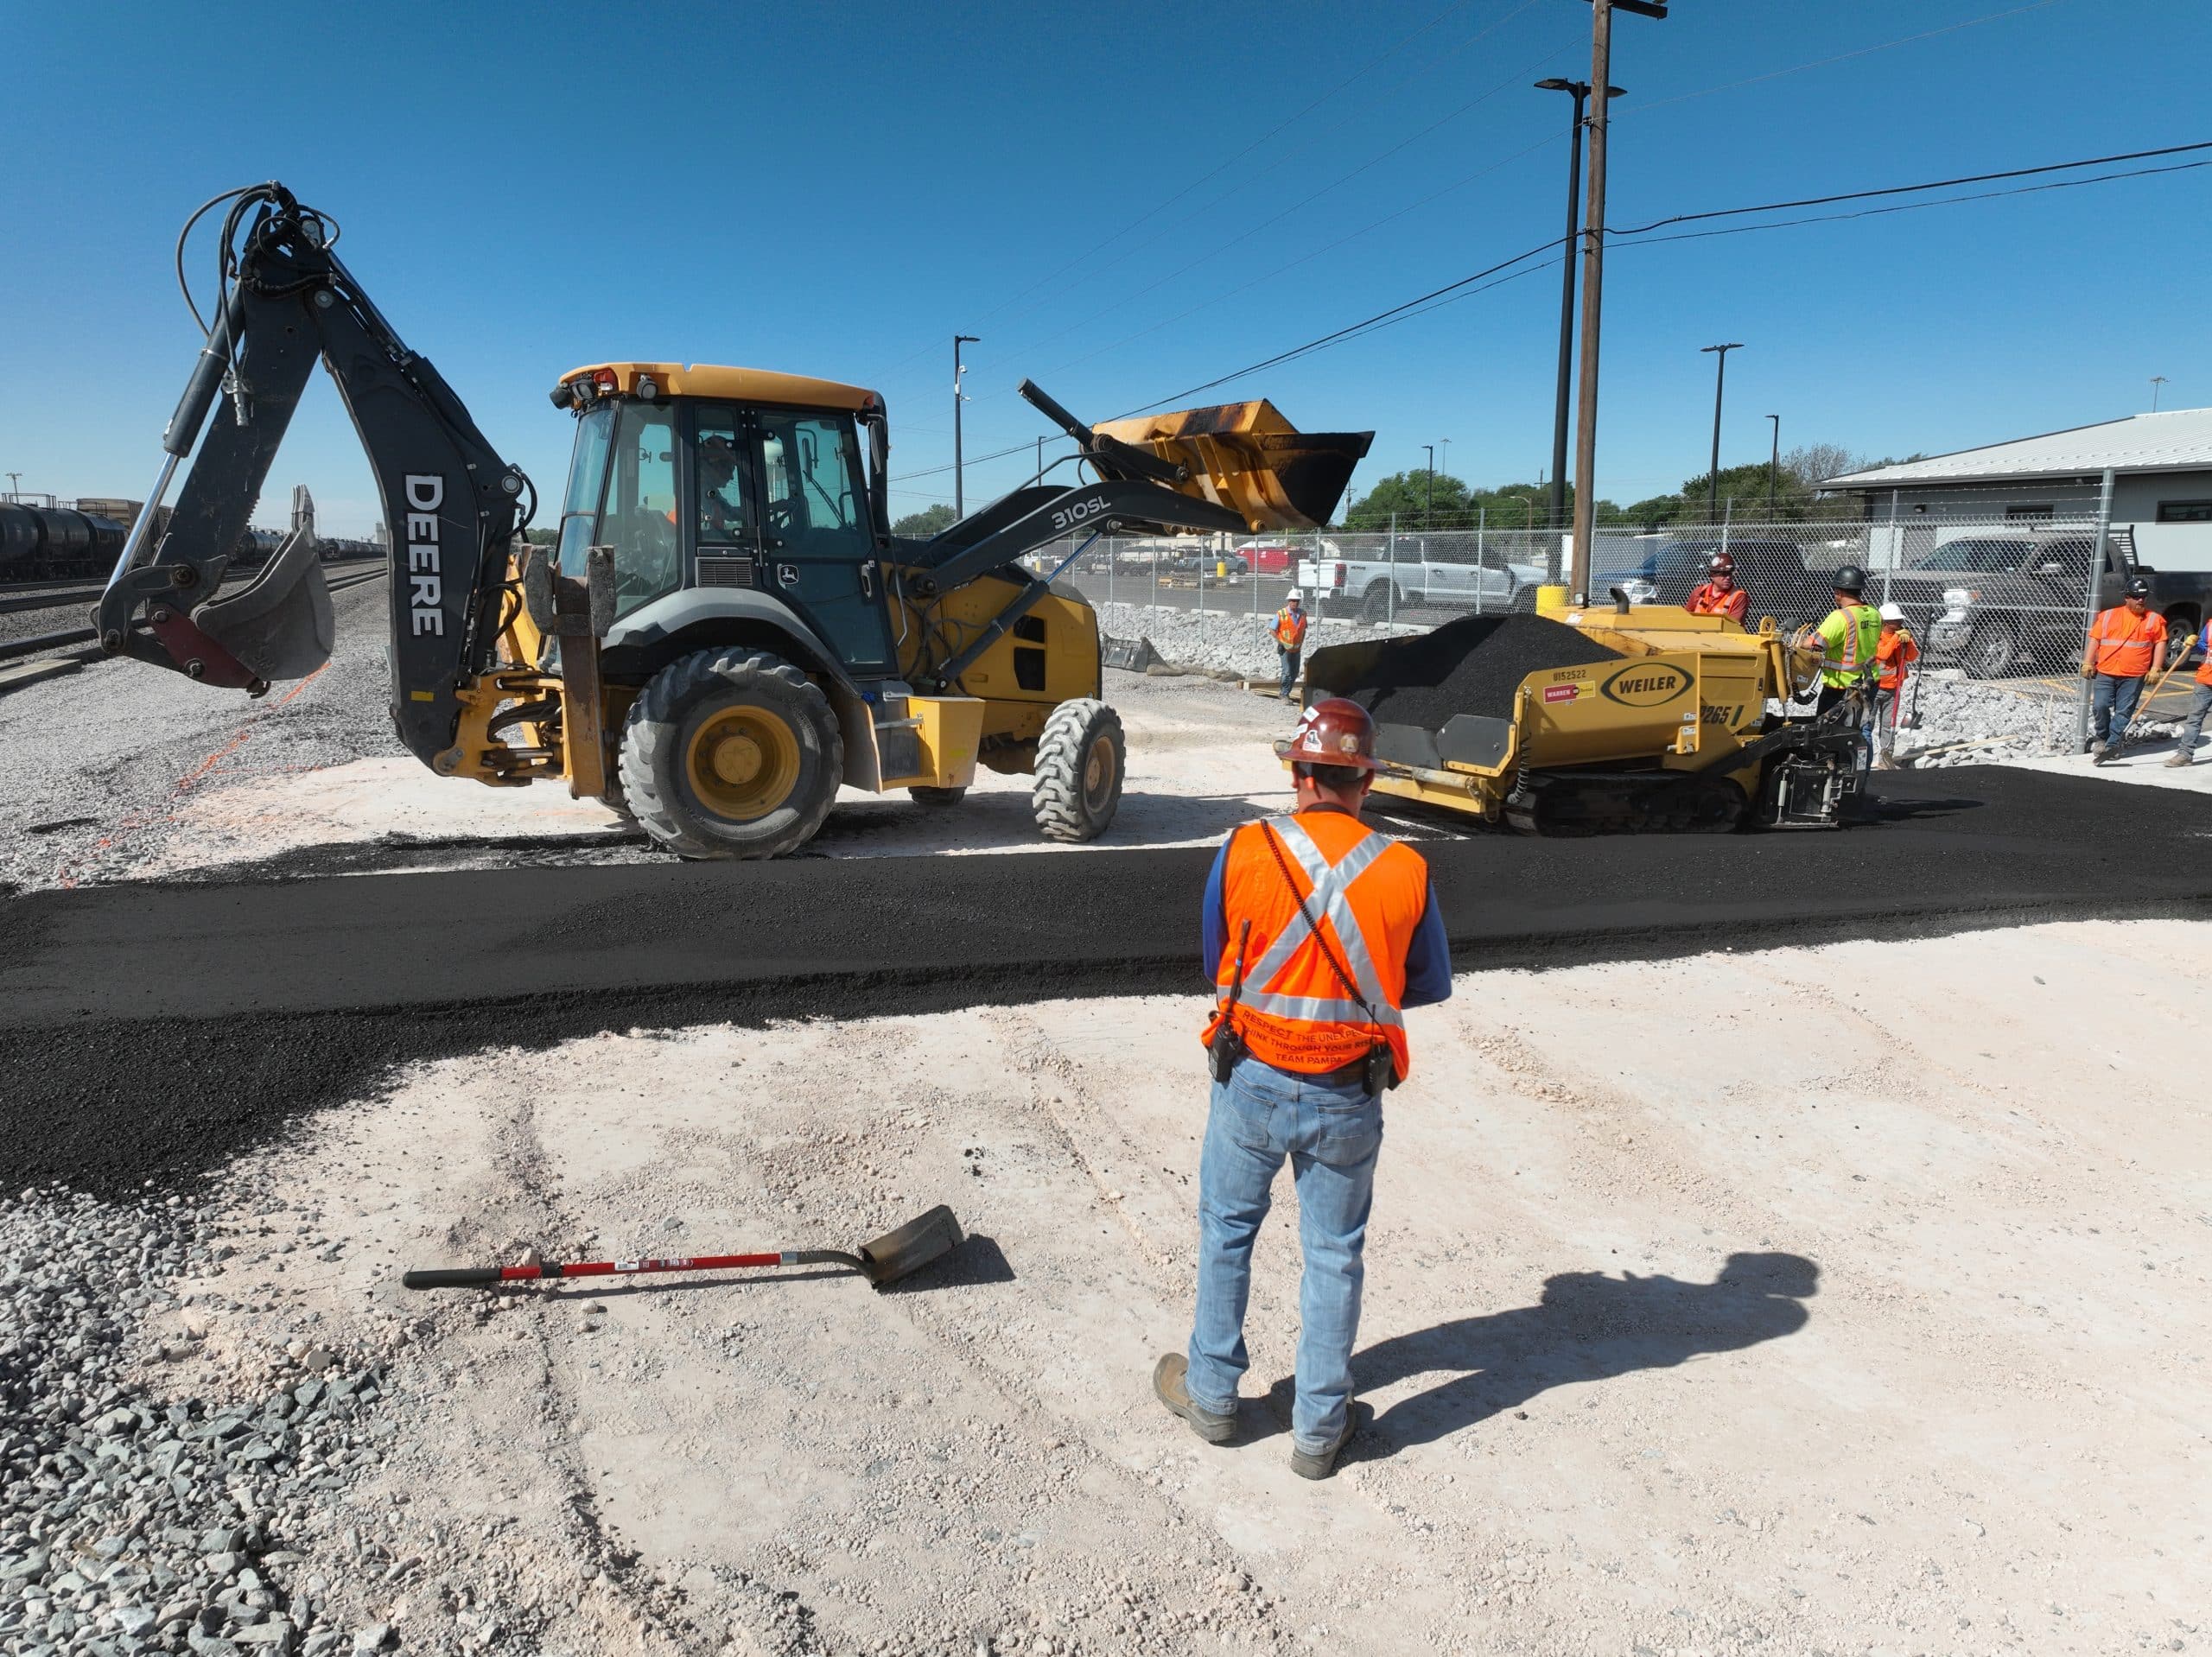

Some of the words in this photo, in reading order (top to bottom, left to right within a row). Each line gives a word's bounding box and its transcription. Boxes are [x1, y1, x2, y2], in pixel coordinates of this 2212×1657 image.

[1052, 495, 1111, 530] 310SL
[405, 474, 443, 636] DEERE
[1618, 676, 1677, 695] WEILER
[1243, 1010, 1294, 1038] RESPECT
[1297, 1034, 1316, 1043] THE
[1271, 1038, 1321, 1052] THROUGH
[1325, 1043, 1352, 1052] YOUR
[1275, 1053, 1304, 1063] TEAM
[1307, 1056, 1342, 1065] PAMPA
